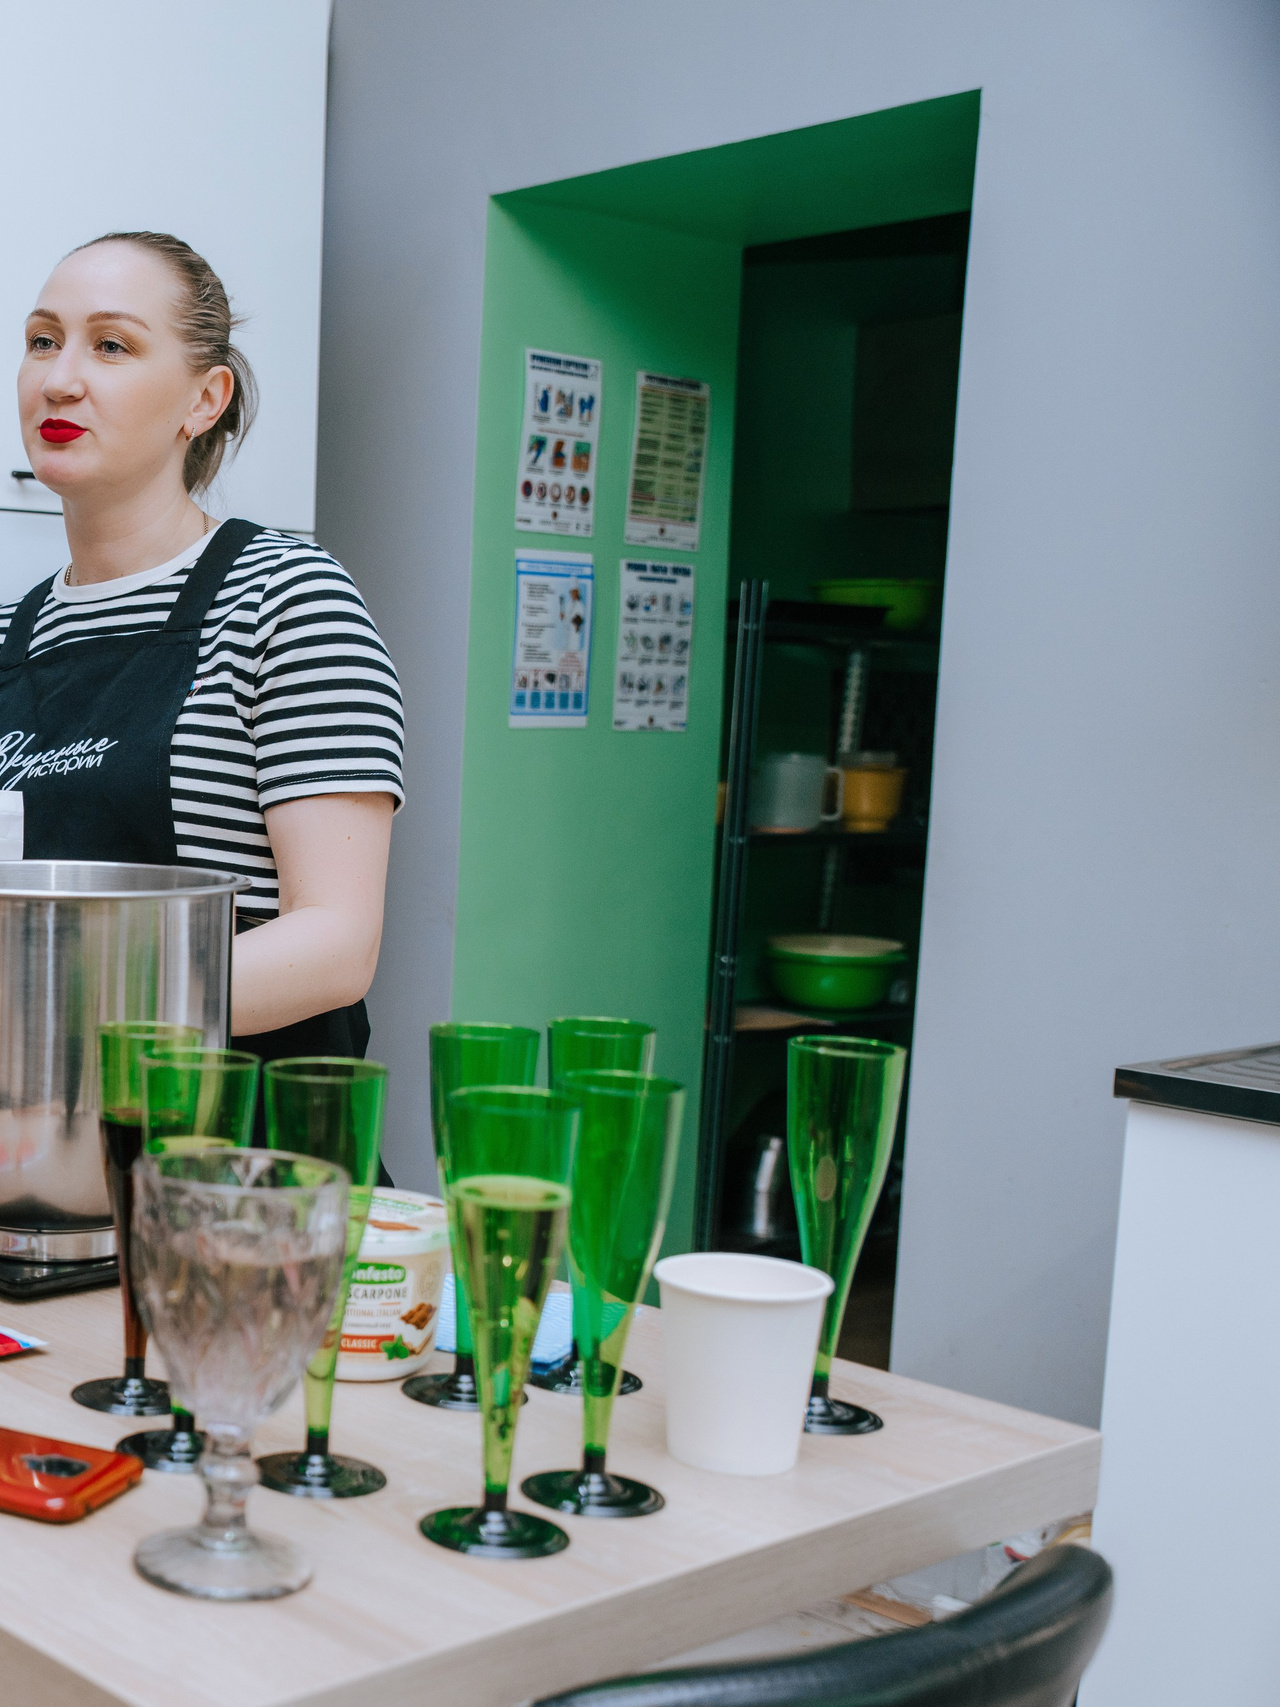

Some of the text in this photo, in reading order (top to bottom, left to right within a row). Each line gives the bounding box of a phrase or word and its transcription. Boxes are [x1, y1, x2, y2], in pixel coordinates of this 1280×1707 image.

[353, 1265, 402, 1282] nfesto
[349, 1286, 408, 1300] CARPONE
[340, 1338, 377, 1349] CLASSIC
